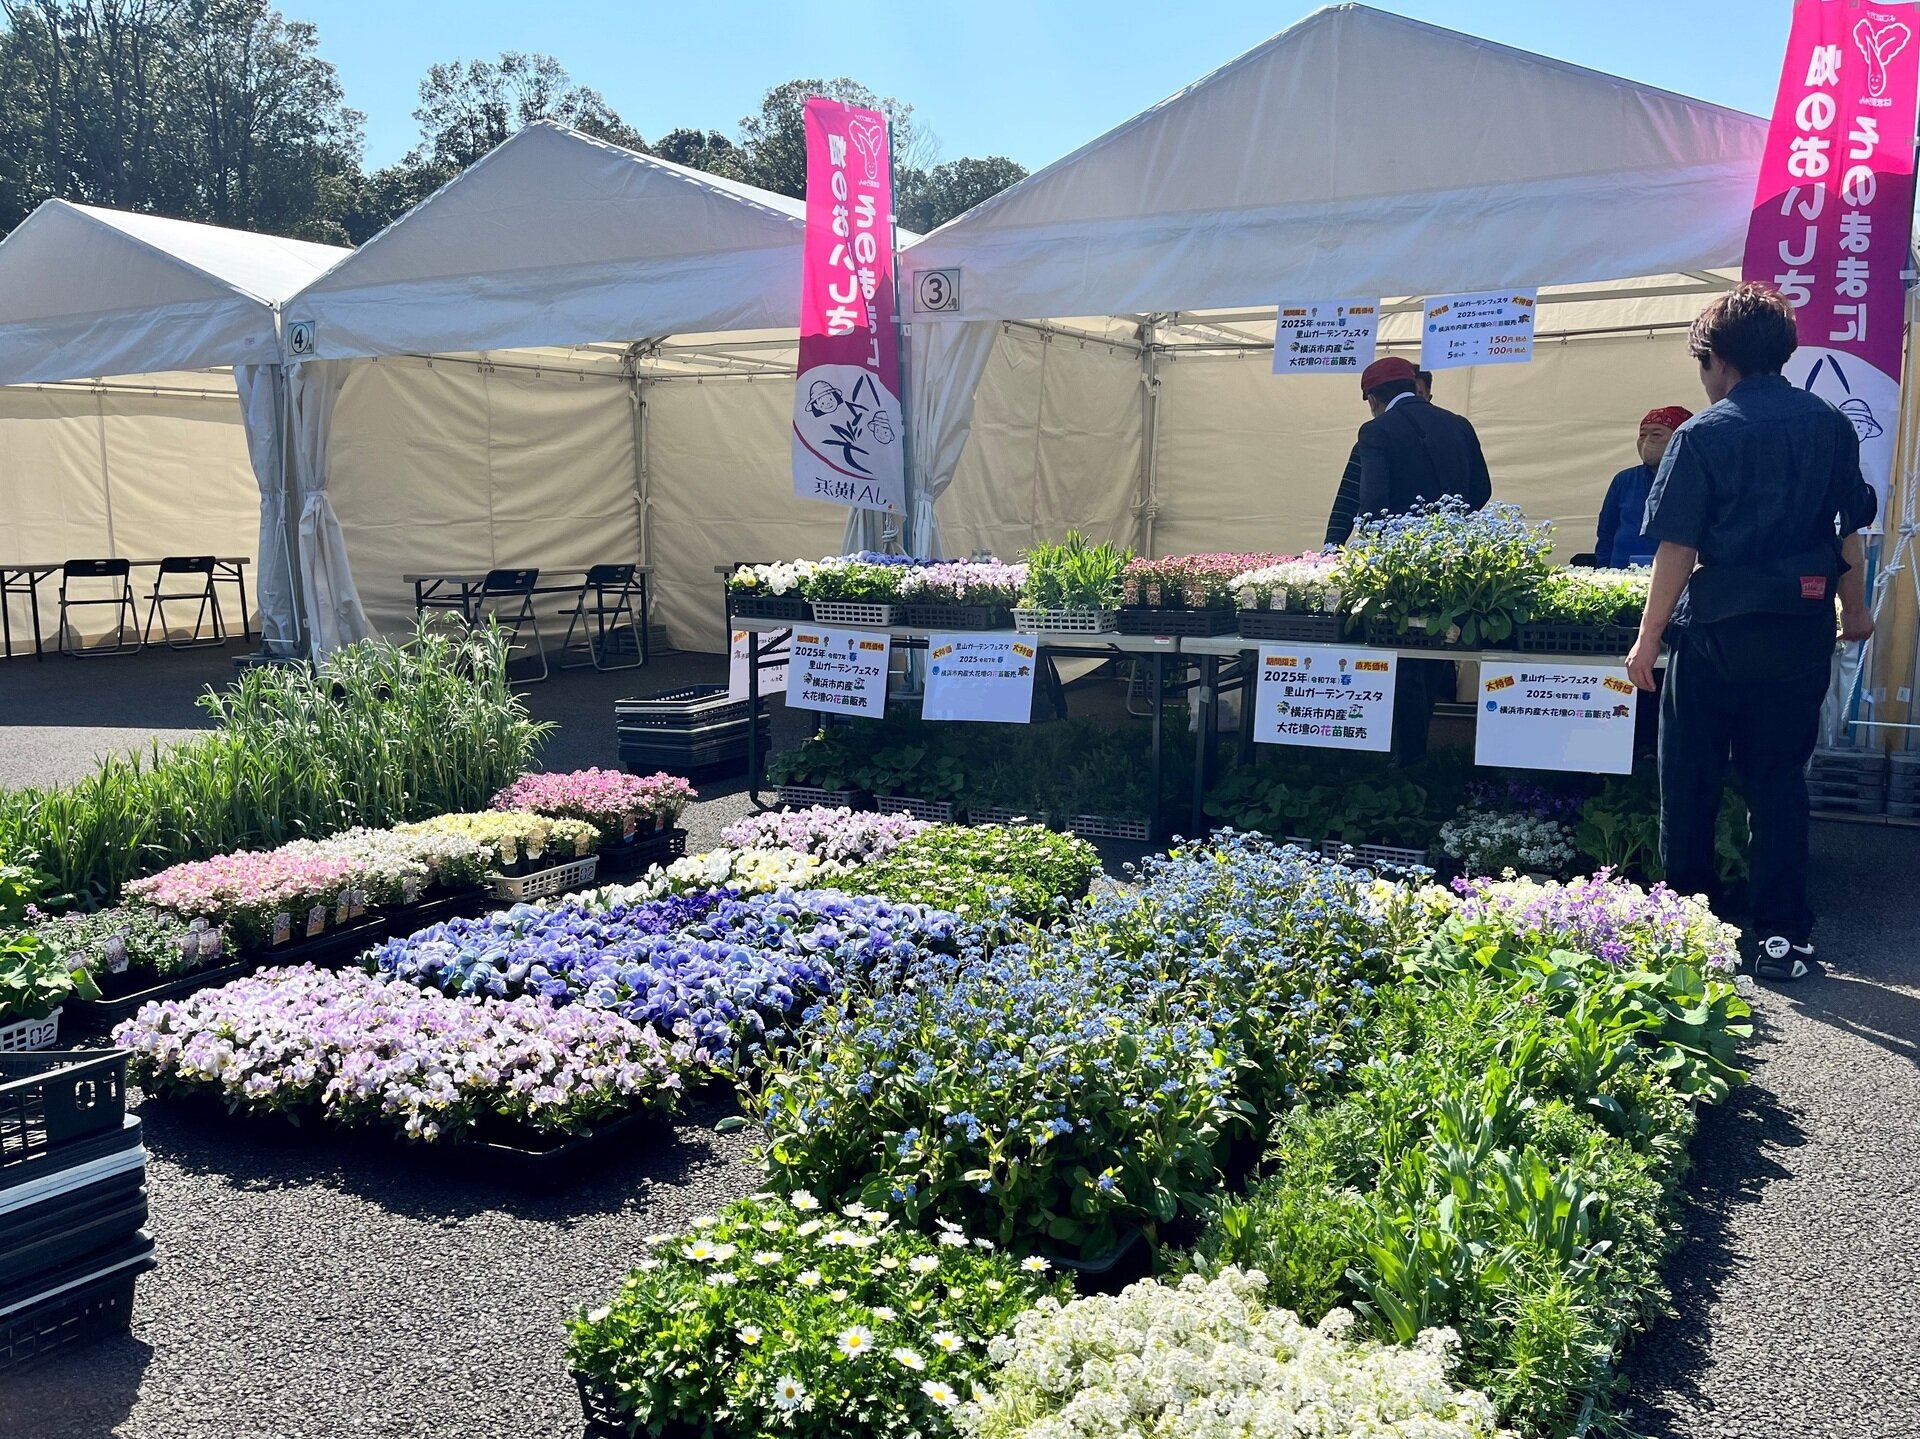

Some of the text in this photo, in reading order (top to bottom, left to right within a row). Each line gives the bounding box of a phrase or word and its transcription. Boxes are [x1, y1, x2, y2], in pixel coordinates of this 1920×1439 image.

[1453, 297, 1508, 308] 里山ガーデンフェスタ
[1296, 329, 1368, 338] 里山ガーデンフェスタ
[1300, 344, 1342, 353] 横浜市内産
[1290, 357, 1356, 366] 大花壇の花苗販売
[809, 661, 879, 676] 里山ガーデンフェスタ
[1266, 657, 1388, 671] 期間限定 直売価格
[813, 677, 853, 690] 横浜市内産
[1486, 676, 1515, 691] 大特価
[1520, 674, 1598, 684] 里山ガーデンフェスタ
[1603, 677, 1634, 694] 大特価
[803, 692, 867, 707] 大花壇の花苗販売
[1284, 686, 1382, 701] 里山ガーデンフェスタ
[1291, 706, 1347, 720] 横浜市内産
[1500, 706, 1611, 719] 横浜市内産大花壇の花苗販売
[1277, 722, 1366, 739] 大花壇の花苗販売
[30, 1023, 55, 1046] 02
